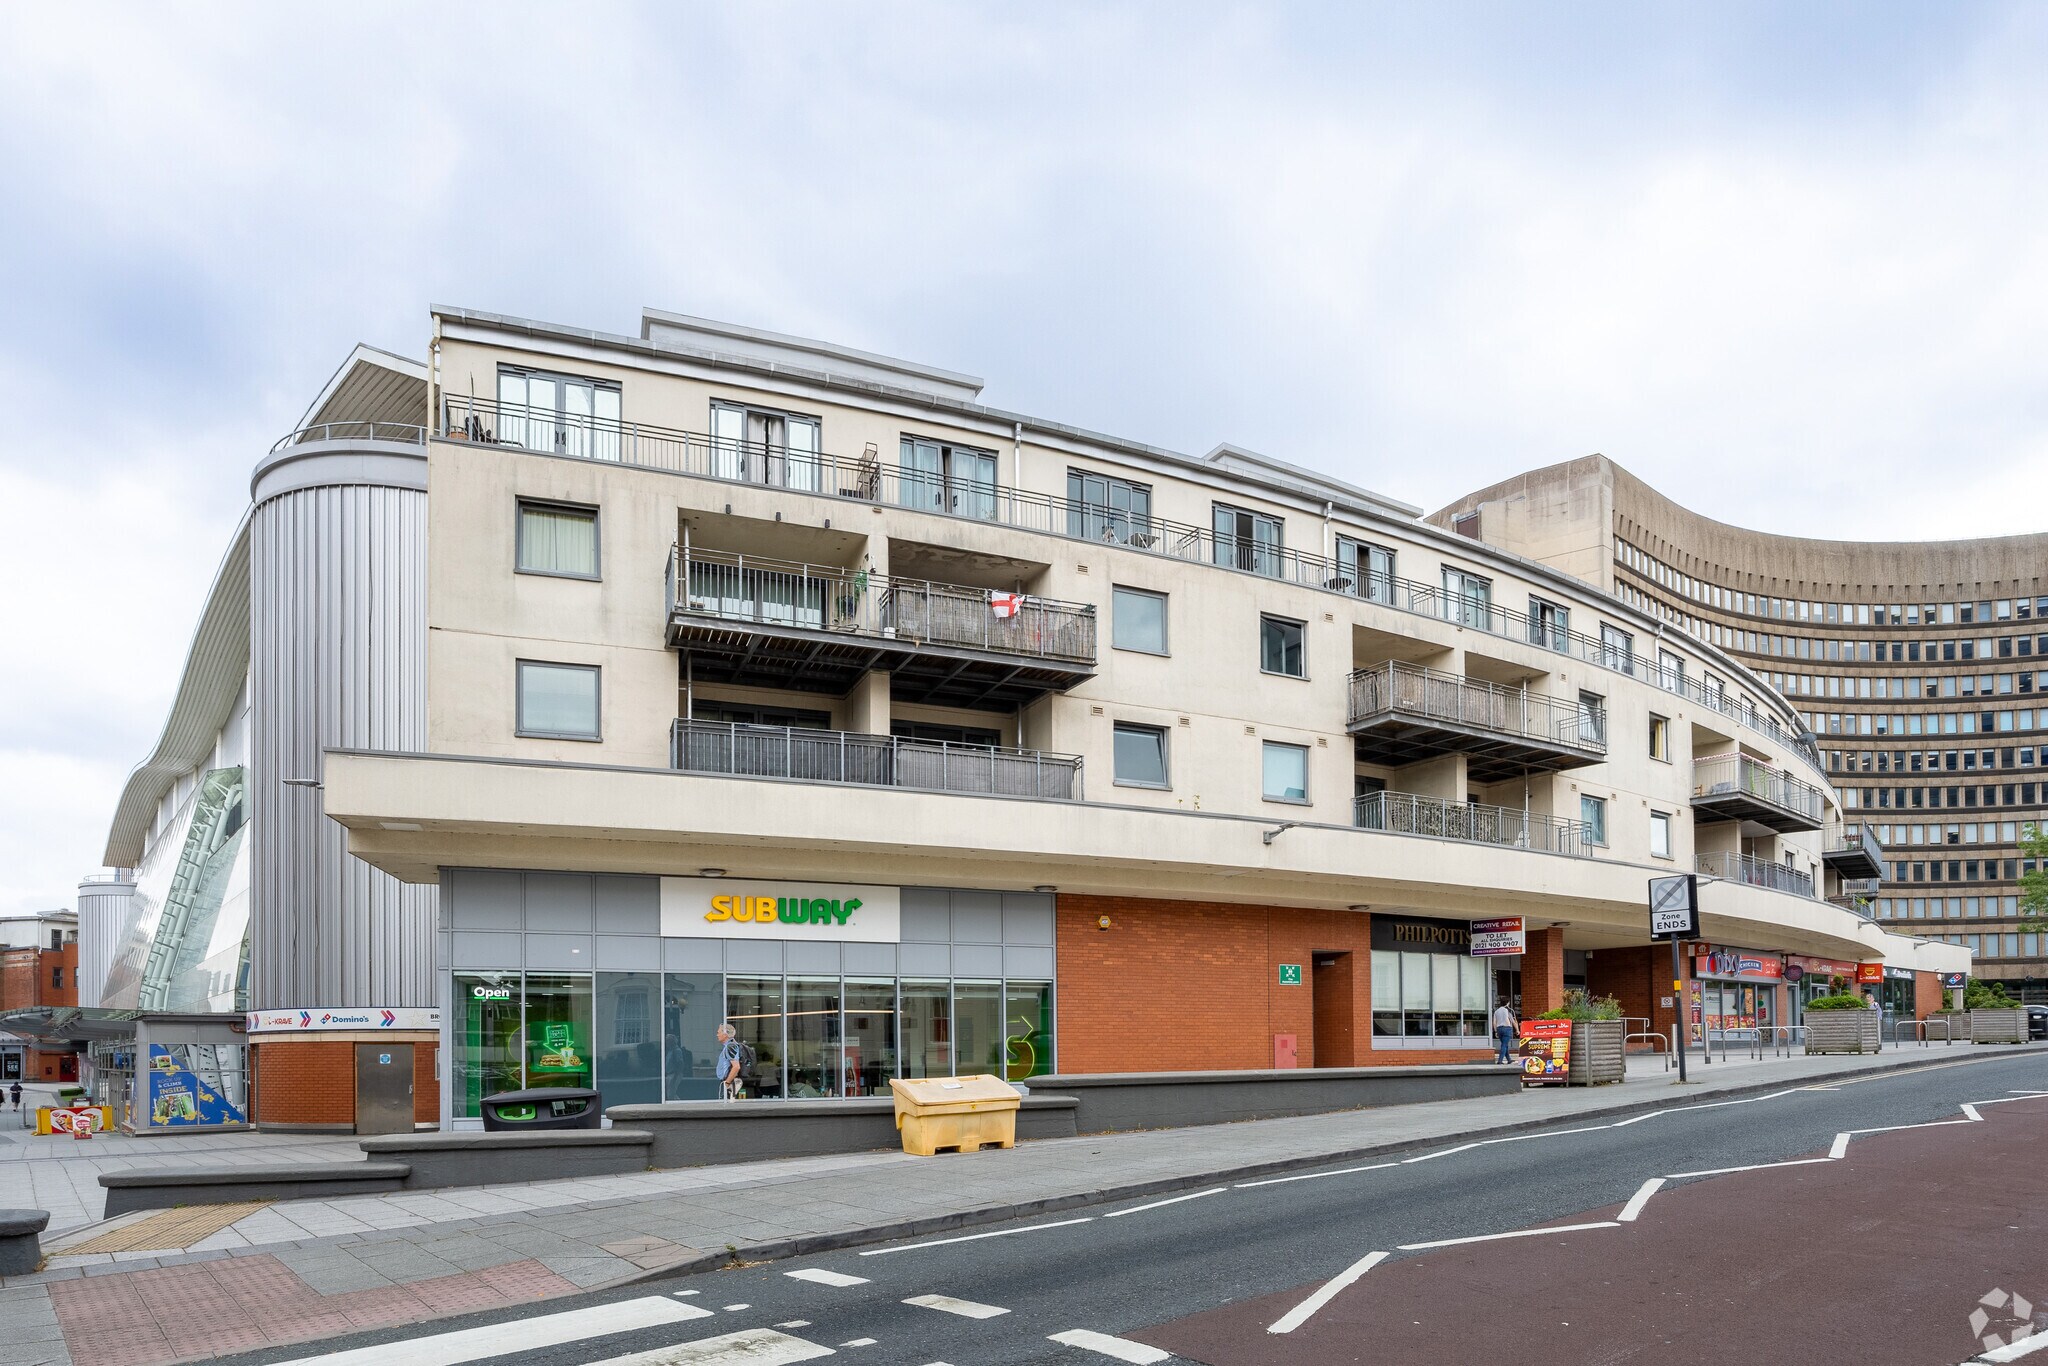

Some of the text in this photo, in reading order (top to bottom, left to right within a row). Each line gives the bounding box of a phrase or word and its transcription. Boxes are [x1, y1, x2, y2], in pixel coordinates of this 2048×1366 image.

[704, 895, 863, 925] SUBWAY
[1656, 920, 1687, 930] ENDS
[1394, 924, 1472, 945] PHILPOTTS
[1739, 960, 1760, 969] CHICKEN
[473, 986, 510, 999] Open
[332, 1015, 369, 1023] Domino's
[160, 1085, 188, 1094] INSIDE
